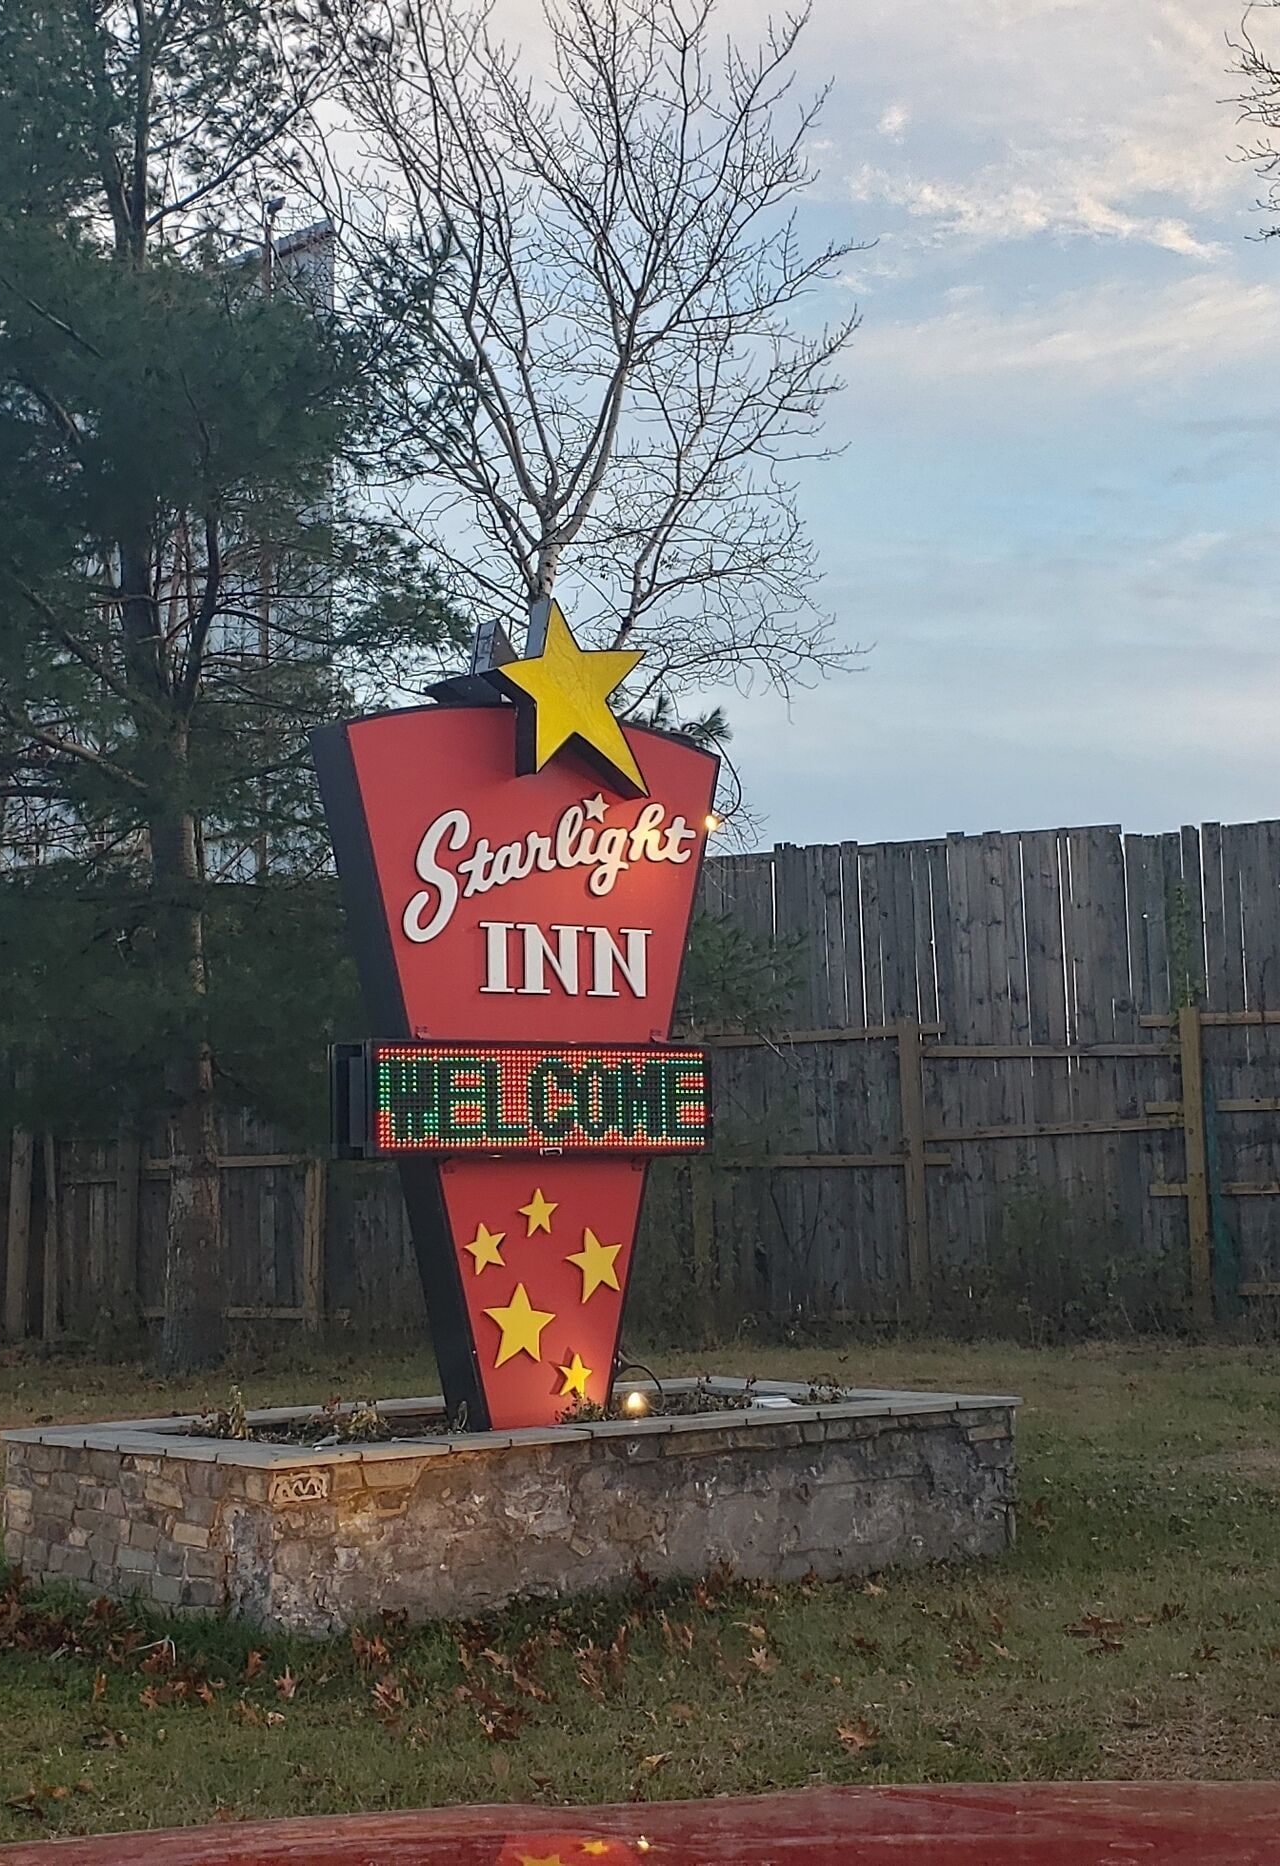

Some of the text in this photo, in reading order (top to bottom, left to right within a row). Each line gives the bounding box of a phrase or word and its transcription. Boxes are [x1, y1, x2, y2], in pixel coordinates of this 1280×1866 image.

[402, 793, 697, 944] Starlight
[479, 921, 652, 998] INN
[381, 1056, 707, 1142] WELCOME
